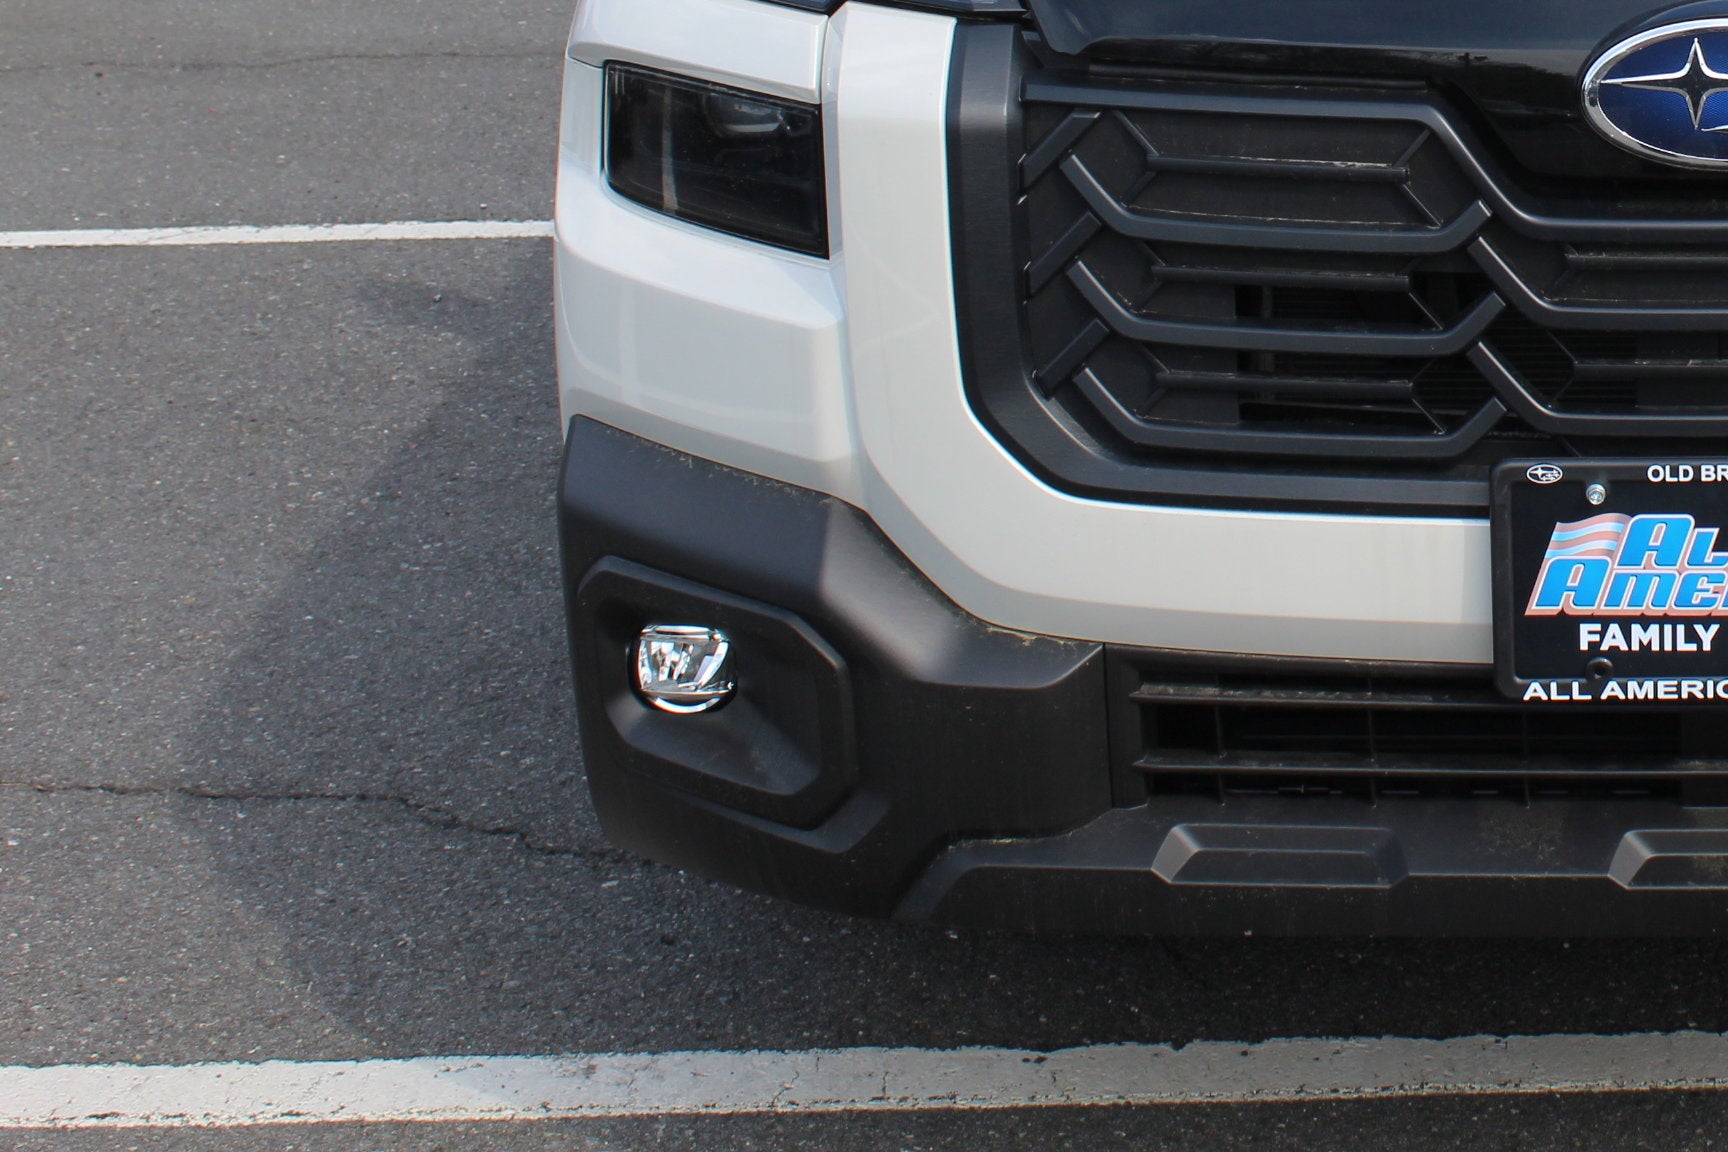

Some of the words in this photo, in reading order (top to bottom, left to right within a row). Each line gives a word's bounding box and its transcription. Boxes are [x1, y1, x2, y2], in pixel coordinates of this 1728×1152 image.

[1647, 464, 1694, 483] OLD
[1579, 624, 1719, 651] FAMILY
[1523, 680, 1592, 700] ALL
